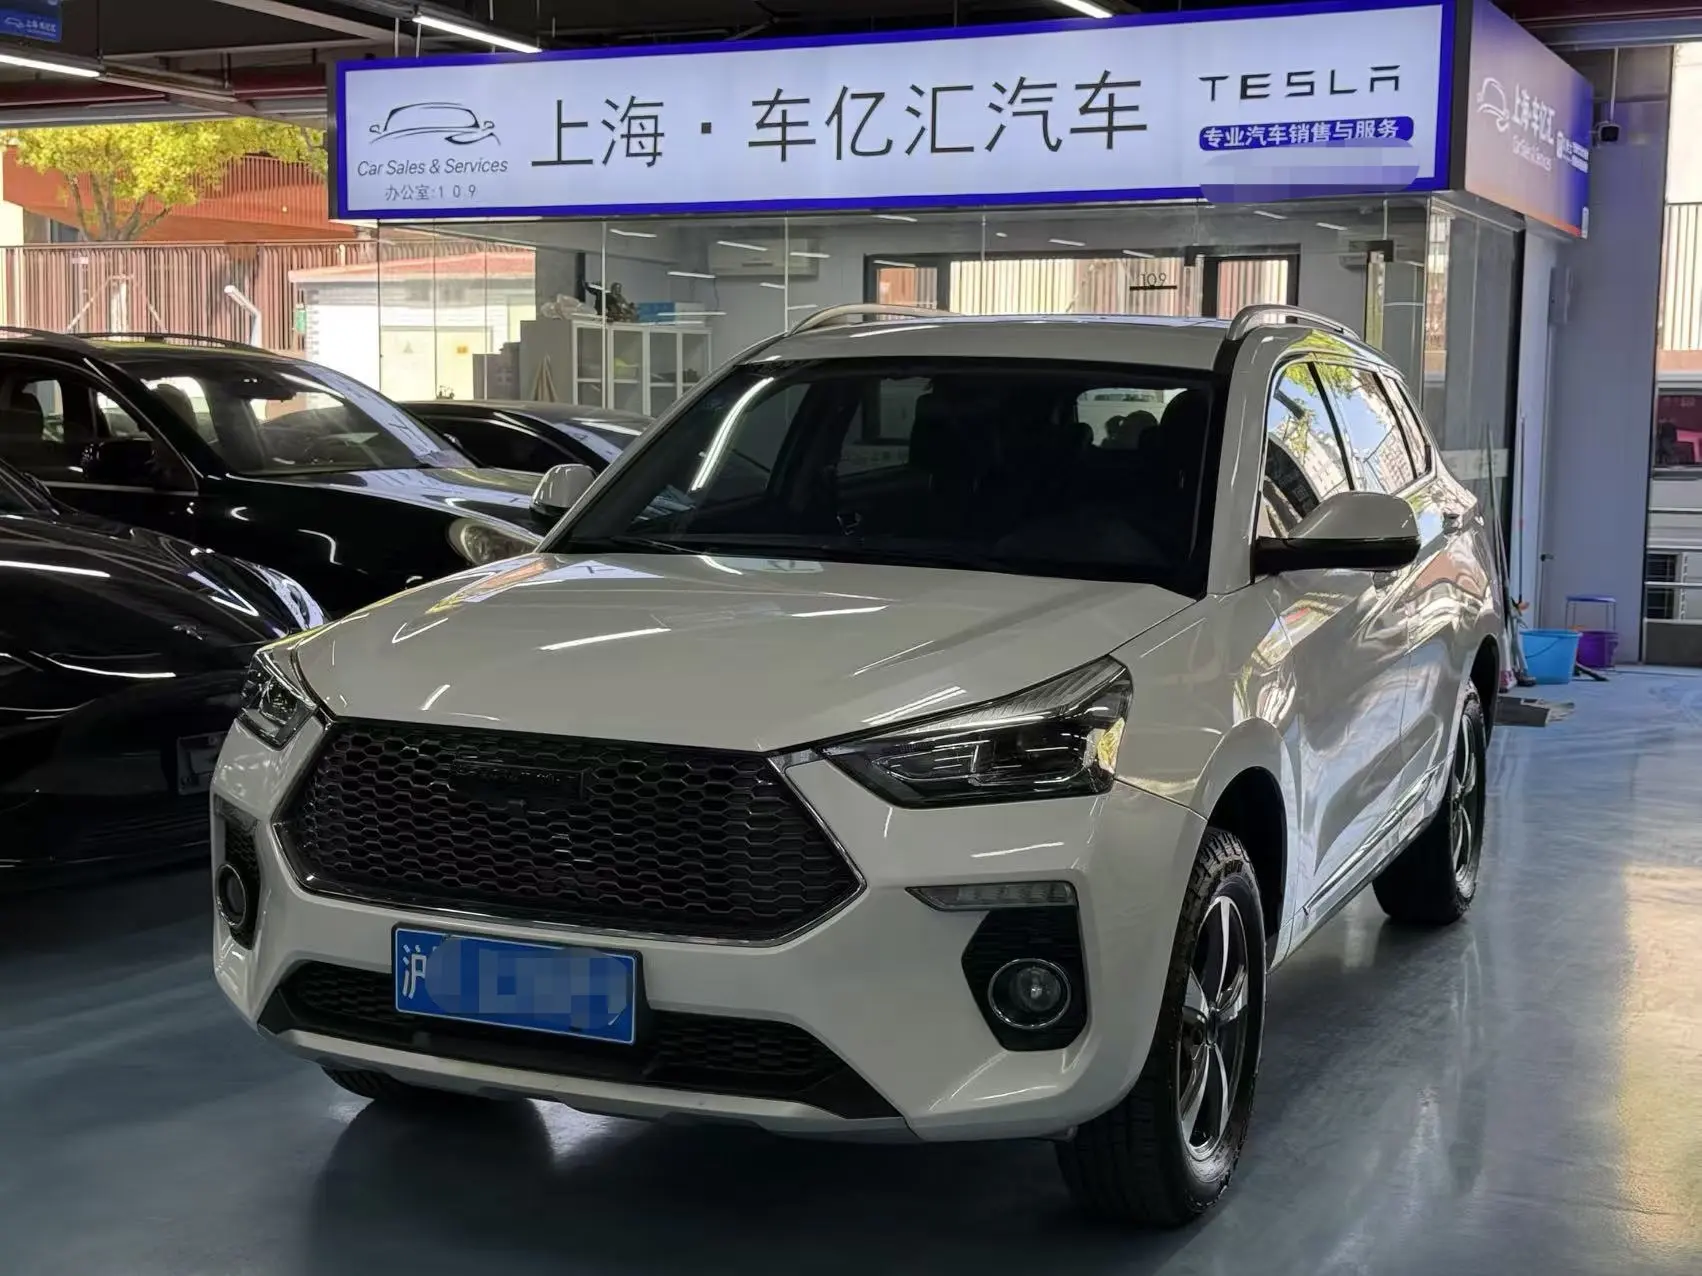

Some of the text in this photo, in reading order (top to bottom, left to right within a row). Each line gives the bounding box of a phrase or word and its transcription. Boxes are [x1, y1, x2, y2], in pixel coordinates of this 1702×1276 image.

[1199, 65, 1400, 101] TESLA
[1203, 118, 1400, 148] 专业汽车销售与服务
[357, 157, 508, 177] Car Sales & Services
